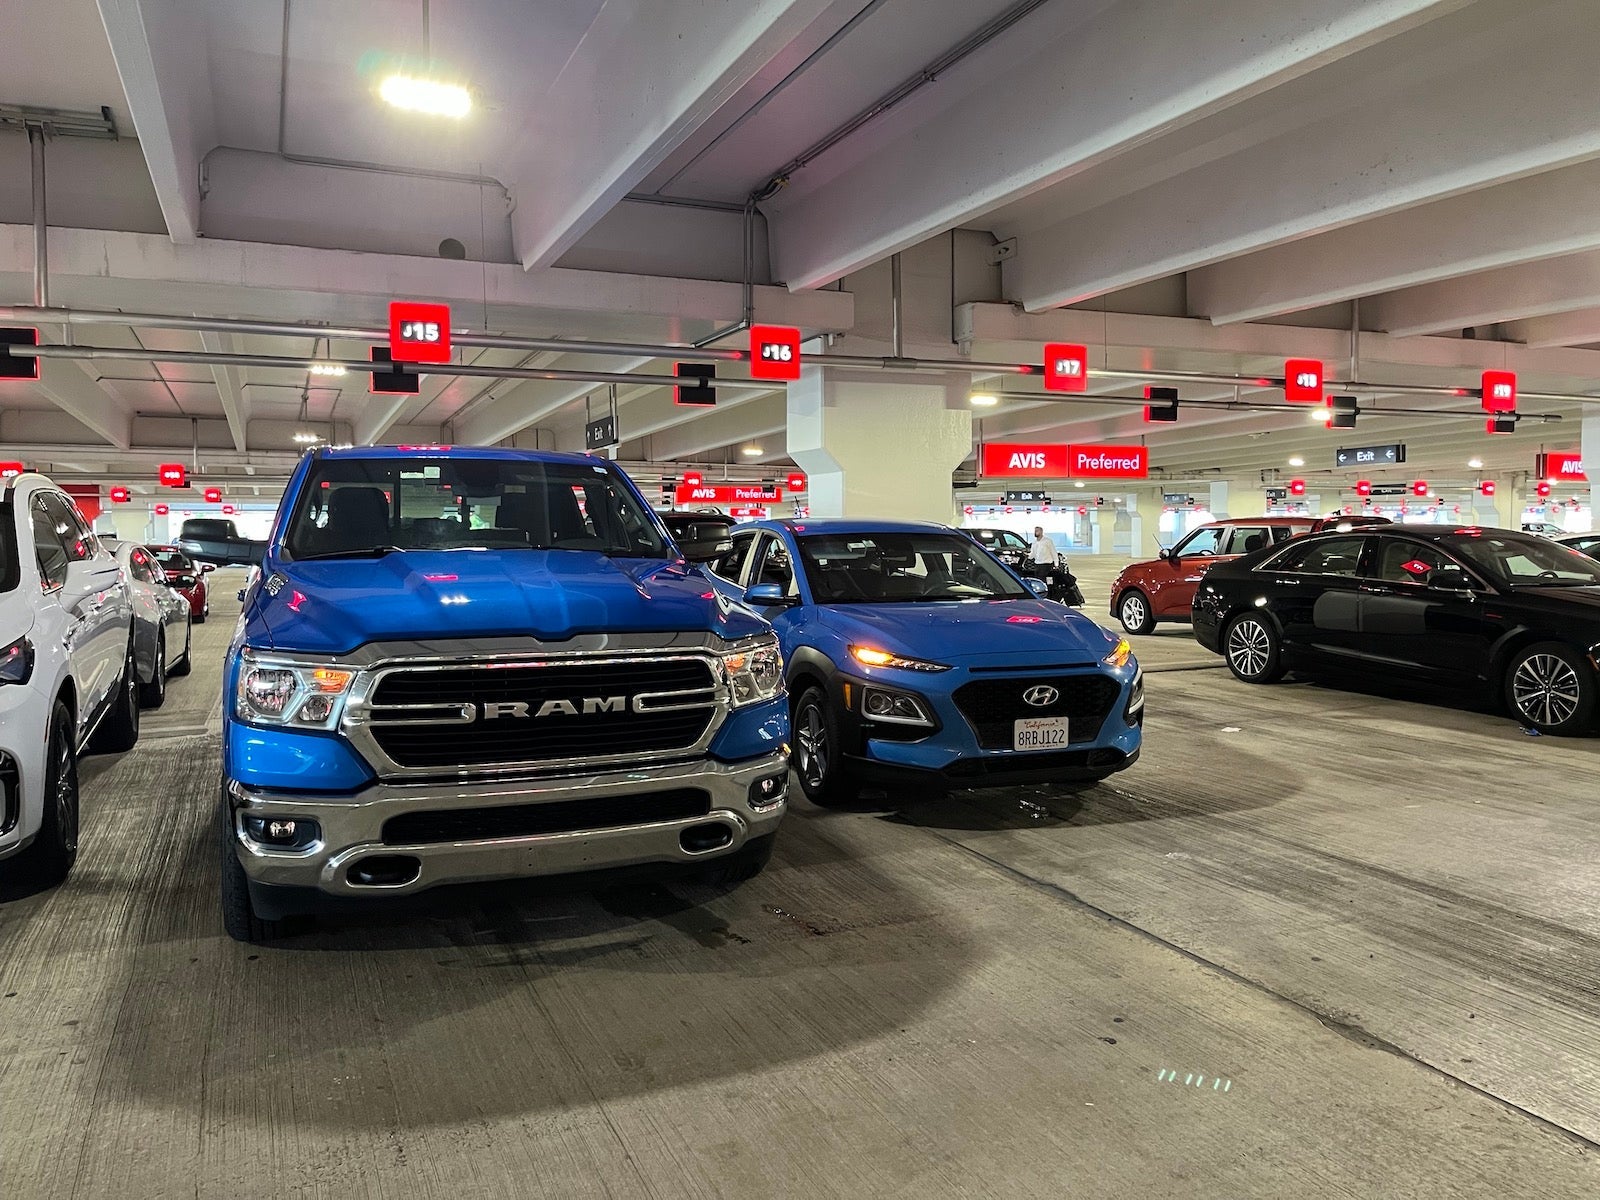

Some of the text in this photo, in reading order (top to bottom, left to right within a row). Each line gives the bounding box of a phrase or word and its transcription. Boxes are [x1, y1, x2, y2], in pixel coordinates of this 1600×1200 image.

[402, 321, 440, 342] J15
[762, 343, 793, 362] J16
[1056, 358, 1081, 375] J17
[1008, 452, 1140, 471] AVIS Preferred
[1356, 450, 1375, 462] Exit
[691, 488, 716, 499] AVIS
[1021, 492, 1033, 500] Exit
[483, 696, 627, 720] RAM
[1025, 719, 1057, 730] California
[1018, 729, 1065, 746] 8RBJ122
